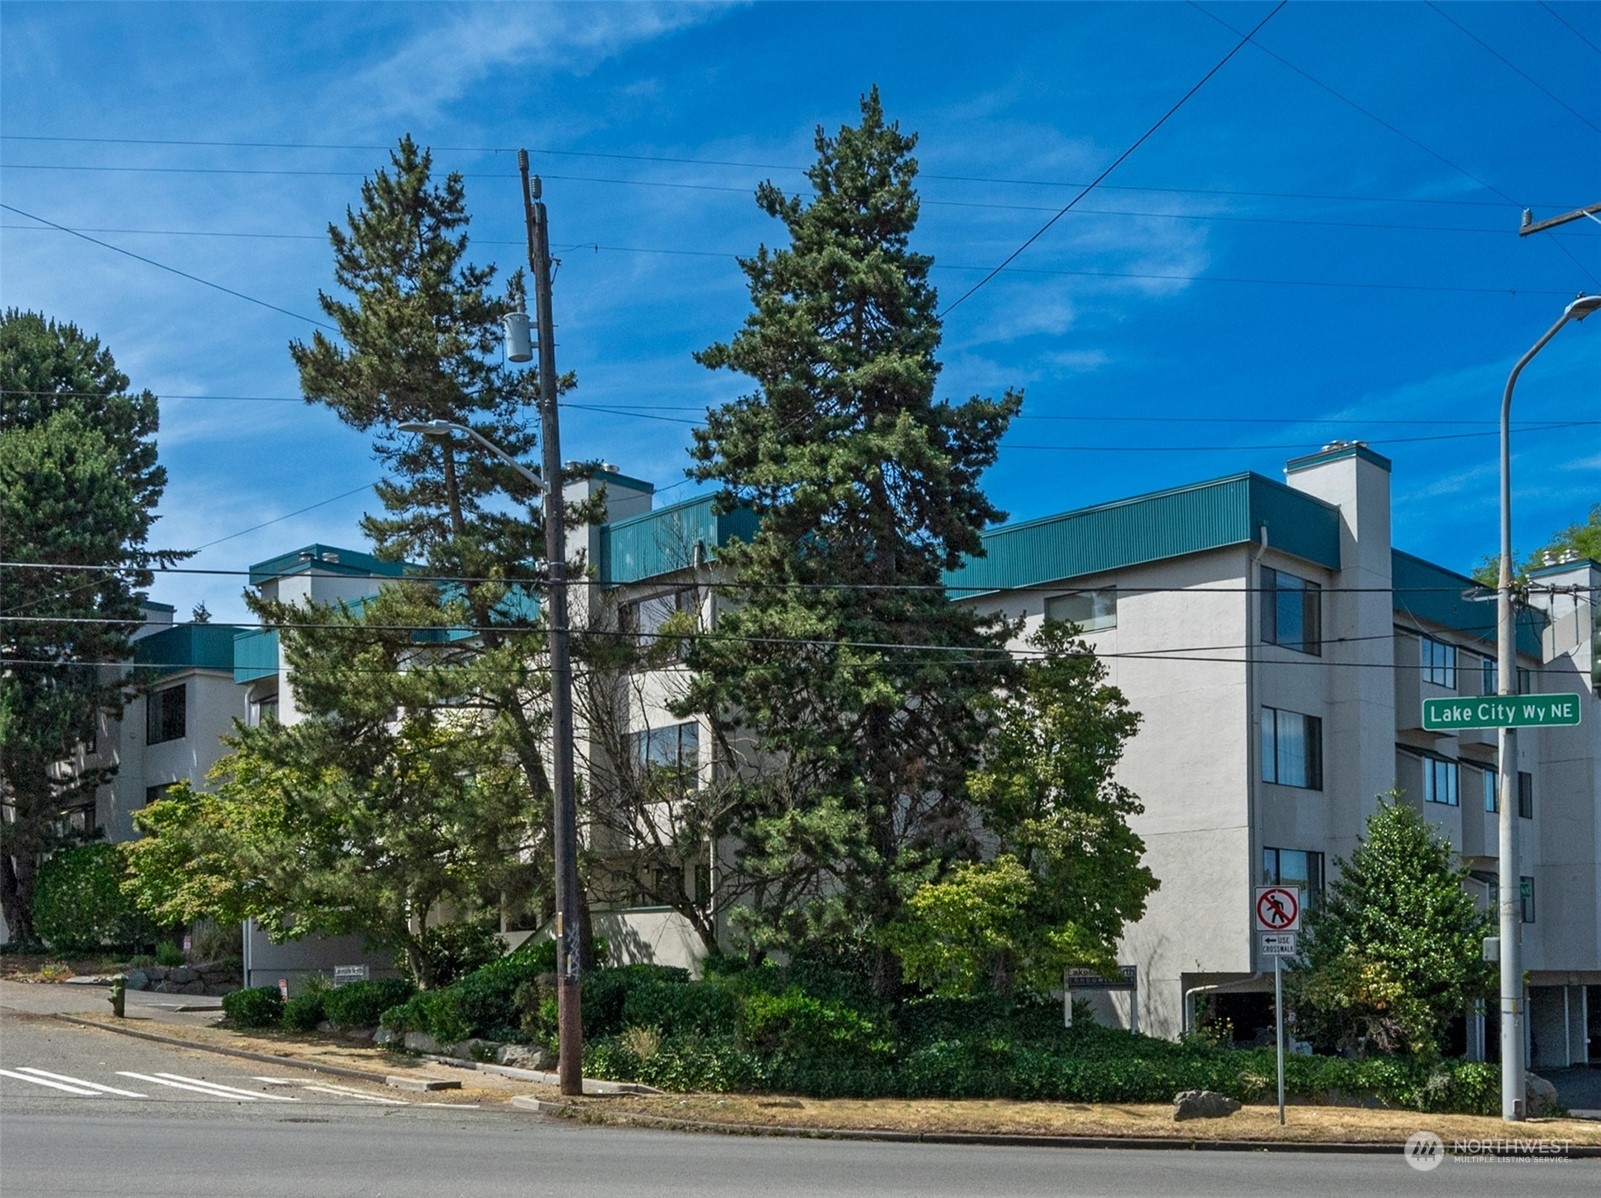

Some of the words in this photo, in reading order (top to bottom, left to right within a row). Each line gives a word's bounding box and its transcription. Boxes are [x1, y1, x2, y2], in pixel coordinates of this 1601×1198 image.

[1430, 705, 1472, 722] Lake
[1478, 703, 1516, 723] City
[1523, 705, 1546, 722] Wy
[1551, 703, 1573, 718] NE
[1262, 945, 1294, 953] CROSSWALK
